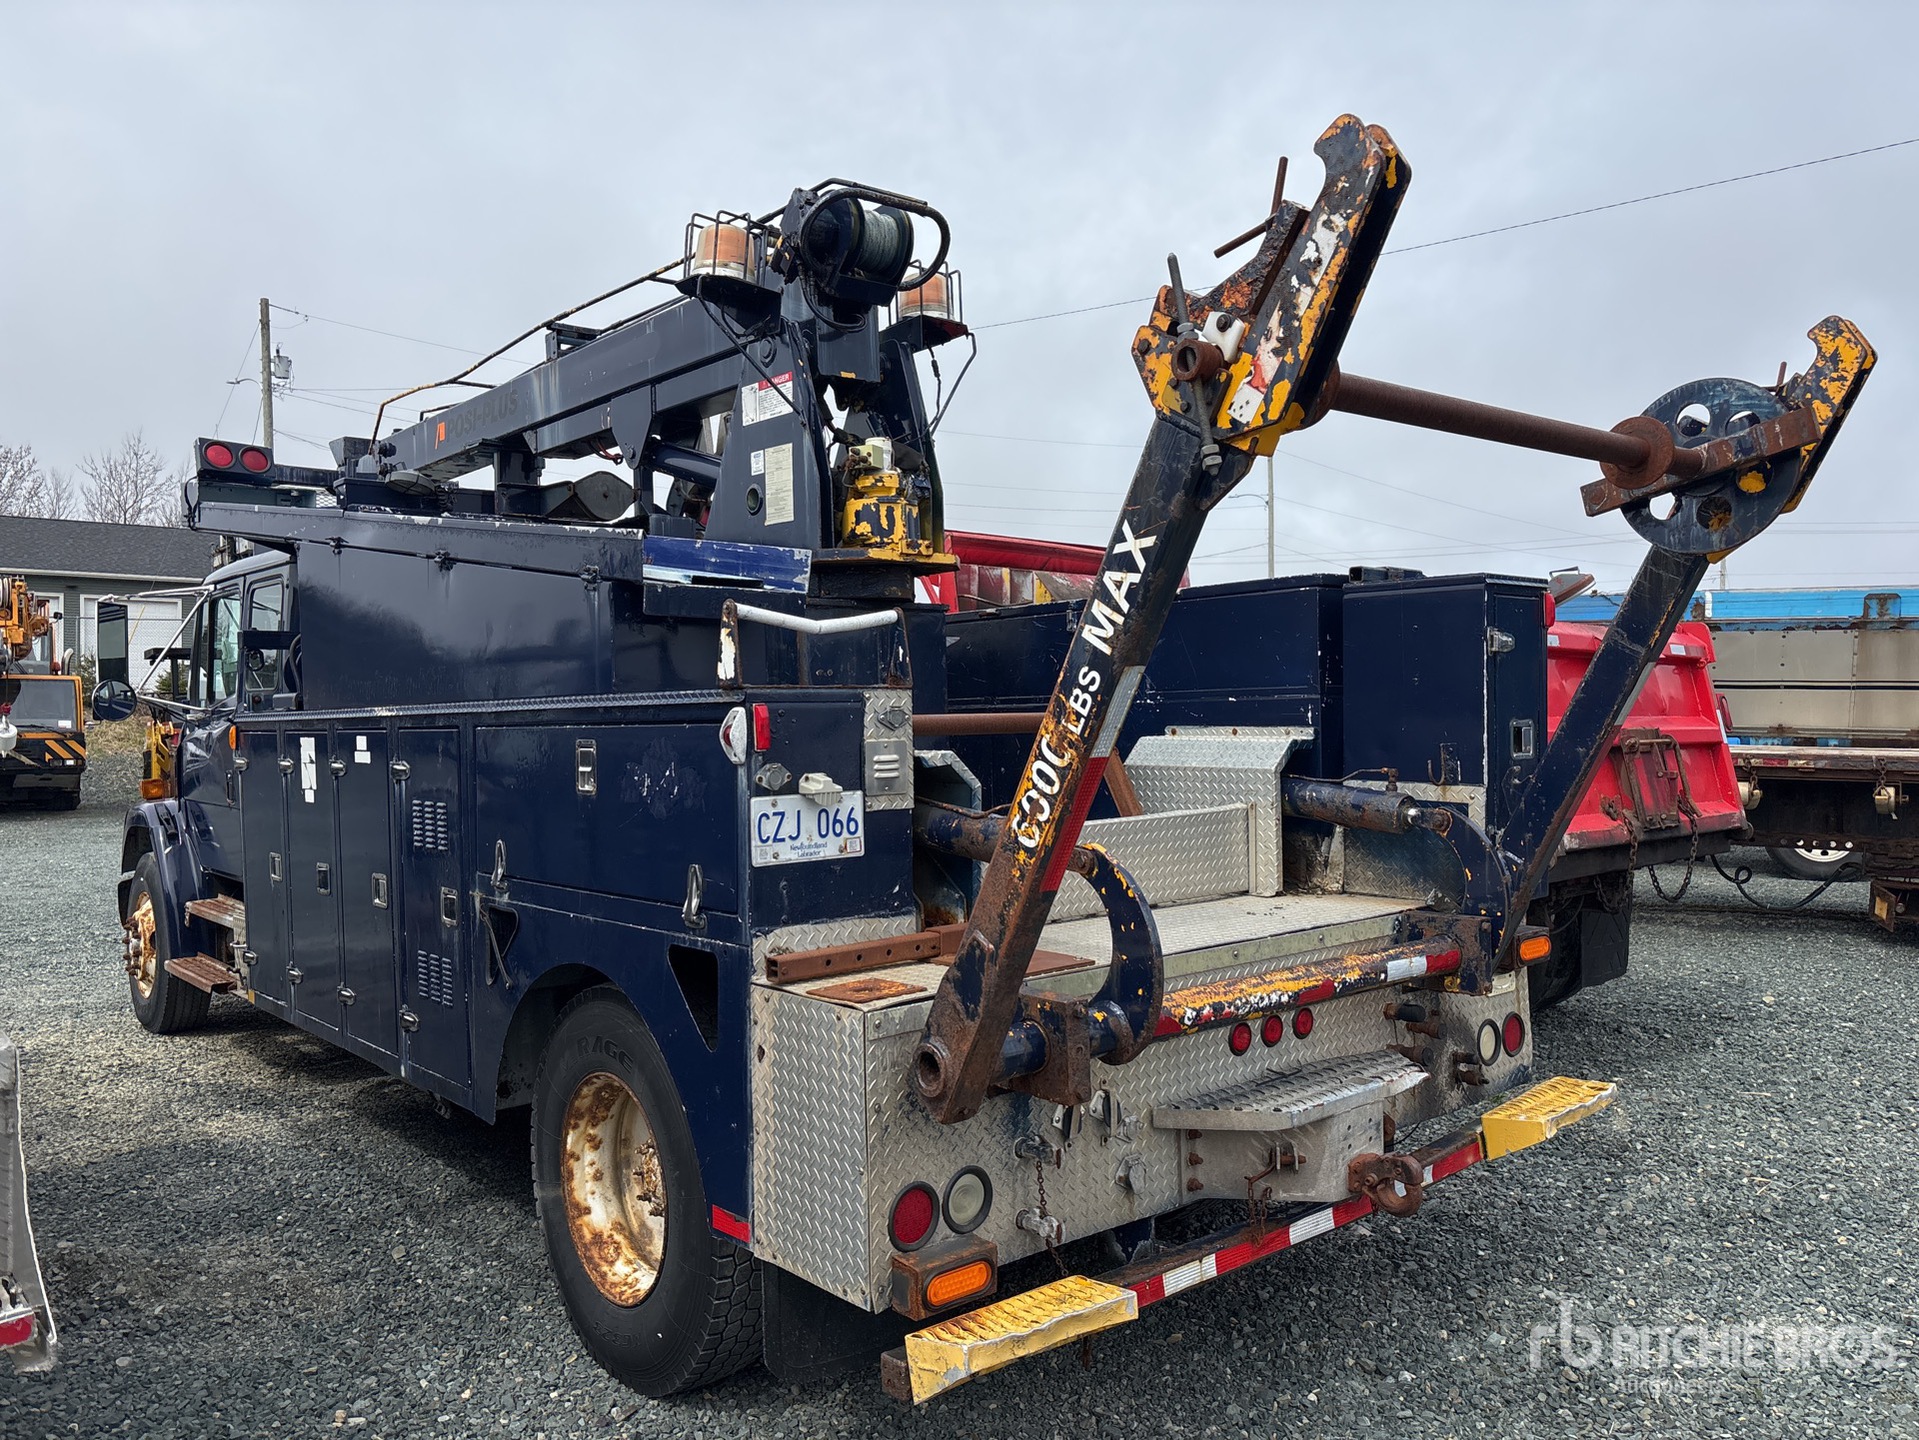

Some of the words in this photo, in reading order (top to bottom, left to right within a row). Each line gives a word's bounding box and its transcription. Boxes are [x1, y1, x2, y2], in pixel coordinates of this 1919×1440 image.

[768, 373, 790, 386] ANGER
[447, 390, 518, 438] POSI-PLUS
[1081, 519, 1157, 656] MAX
[1062, 666, 1101, 737] LBS
[757, 809, 801, 843] CZJ
[817, 807, 859, 838] 066
